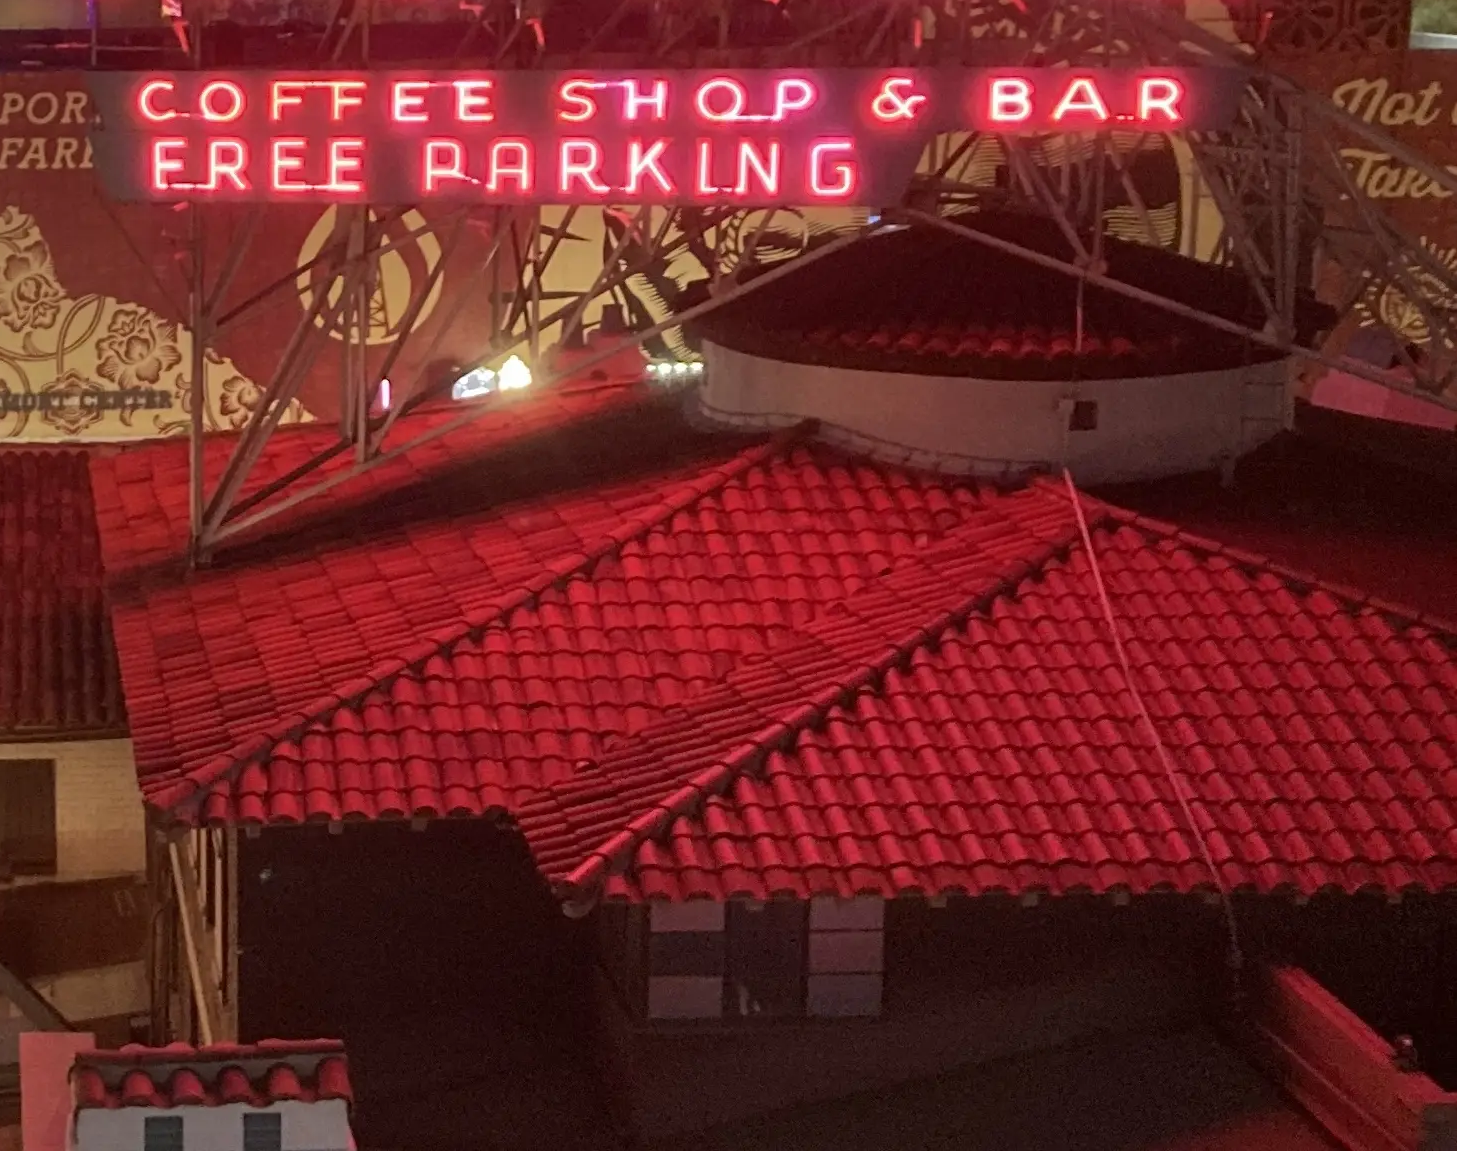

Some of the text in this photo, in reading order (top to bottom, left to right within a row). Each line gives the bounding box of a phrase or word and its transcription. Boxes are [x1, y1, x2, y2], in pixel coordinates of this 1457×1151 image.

[139, 78, 1184, 122] COFFEE SHOP & BAR
[153, 140, 856, 195] FREE PARKING
